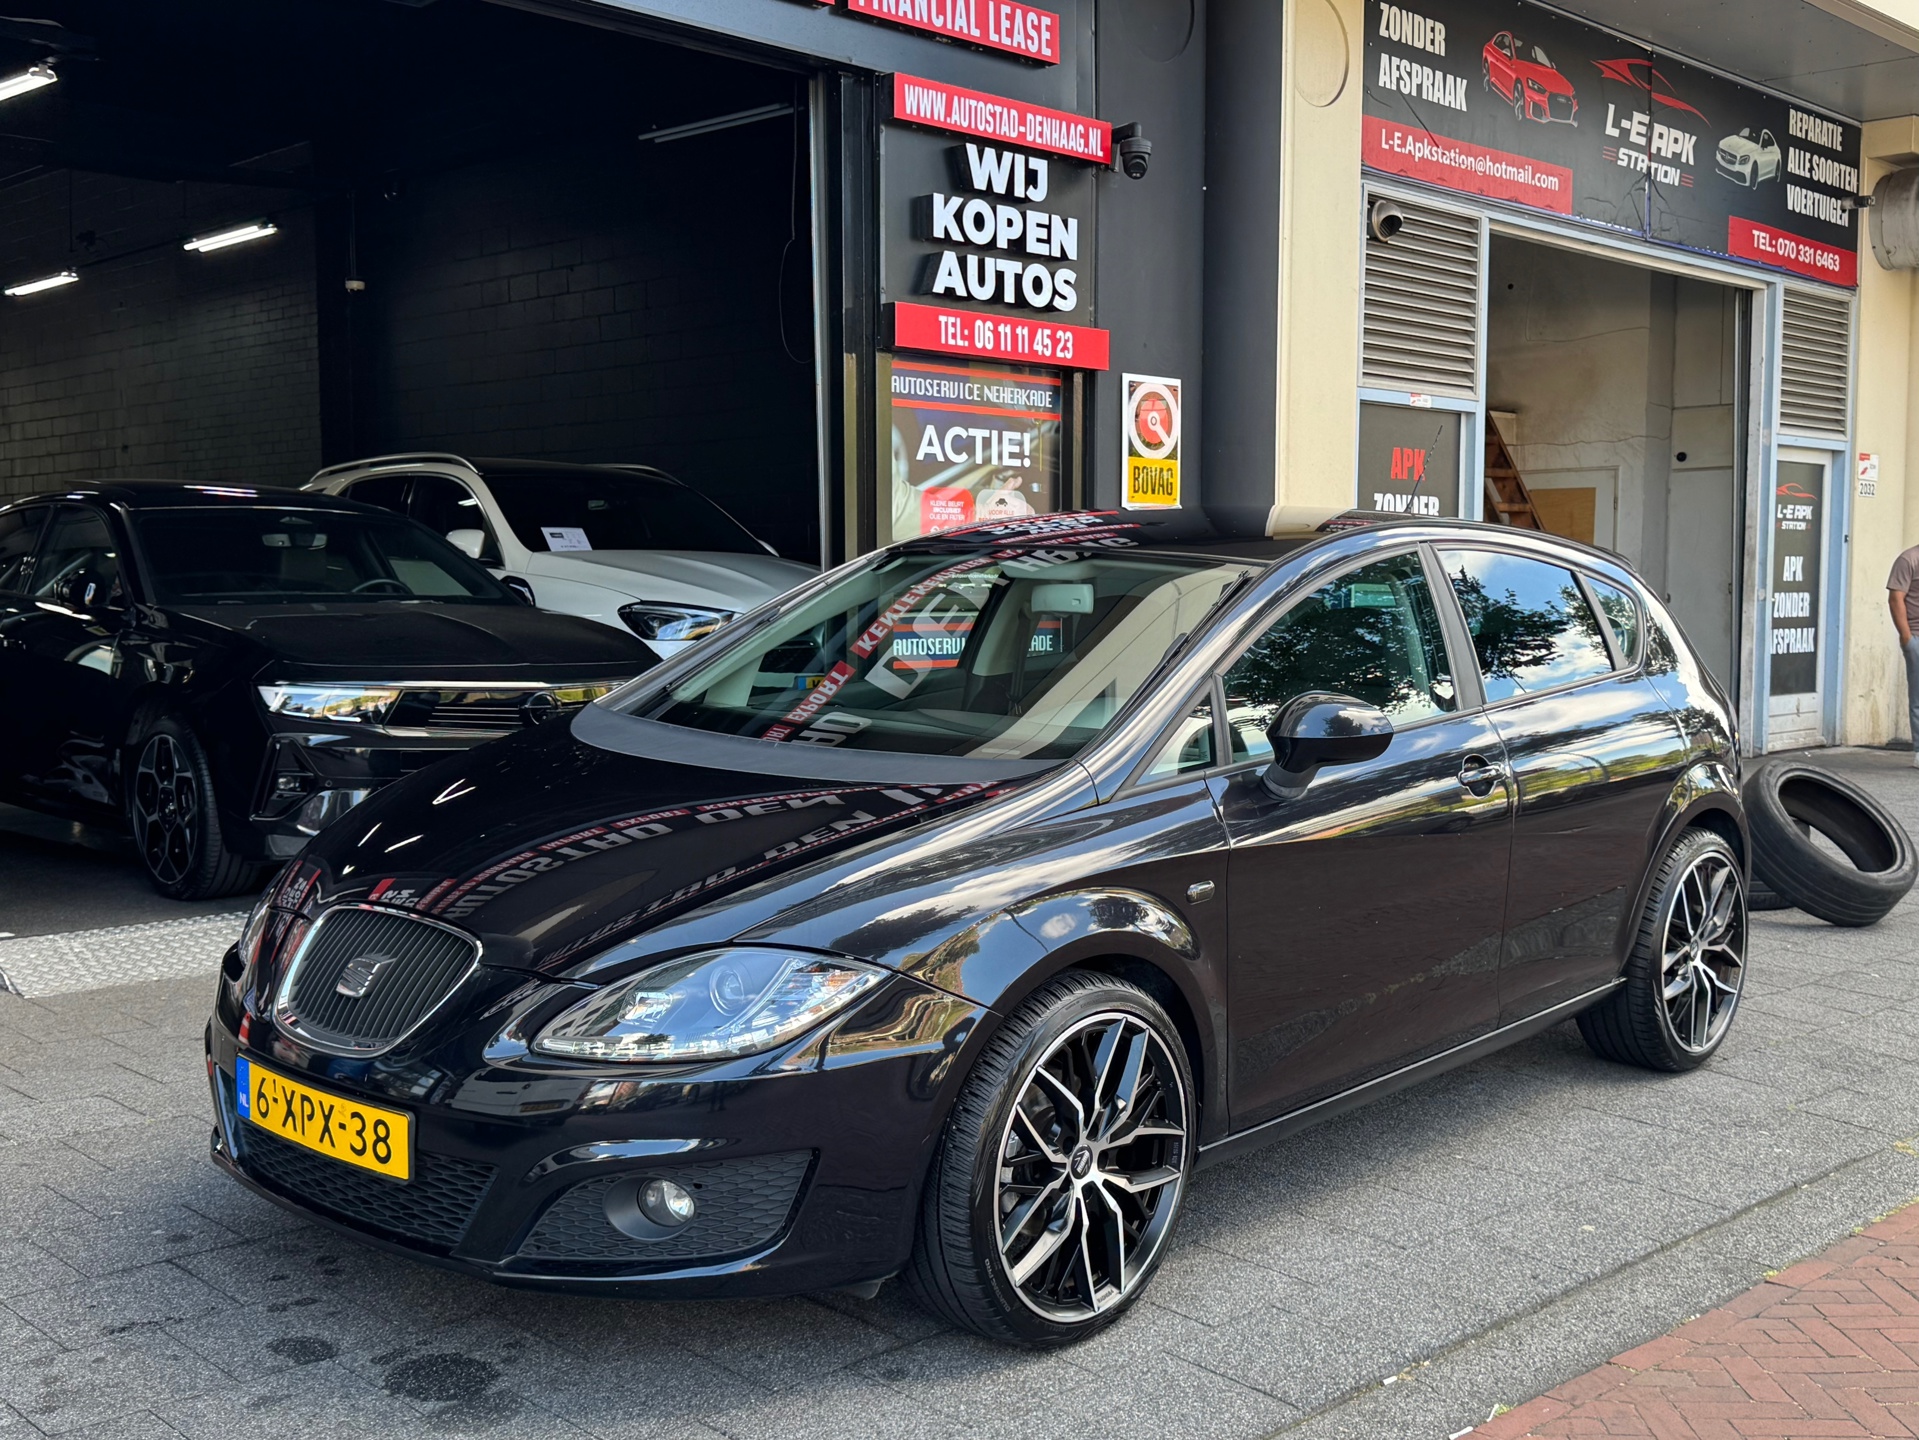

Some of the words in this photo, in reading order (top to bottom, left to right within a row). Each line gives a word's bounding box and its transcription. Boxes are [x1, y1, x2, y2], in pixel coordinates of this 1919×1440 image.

[988, 0, 1053, 57] LEASE
[1378, 1, 1447, 57] ZONDER
[1378, 52, 1468, 112] AFSPRAAK
[904, 83, 1104, 158] WWW.AUTOSTAD-DENHAAG.NL
[1788, 108, 1844, 153] REPARATIE
[1381, 127, 1560, 192] L-E.Apkstation@hotmail.com
[1650, 122, 1698, 165] APK
[965, 142, 1049, 202] WIJ
[1617, 148, 1681, 187] STATION
[1787, 146, 1813, 179] ALLE
[1813, 153, 1858, 194] SOORTEN
[932, 192, 1079, 262] KOPEN
[1752, 229, 1777, 254] TEL:
[1777, 238, 1798, 261] 070
[1798, 243, 1816, 266] 331
[1815, 247, 1841, 273] 6463
[932, 250, 1078, 313] AUTOS
[938, 315, 970, 347] TEL:
[974, 319, 994, 349] 06
[997, 322, 1012, 353] 11
[1015, 326, 1029, 355] 11
[1033, 327, 1052, 357] 45
[1056, 330, 1074, 360] 23
[891, 374, 981, 401] AUTOSERVICE
[983, 384, 1053, 408] NEHERKADE
[915, 424, 1032, 468] ACTIE!
[1390, 447, 1426, 481] APK
[1132, 464, 1174, 497] BOVAG
[1859, 482, 1876, 496] 2032
[1783, 556, 1804, 582] APK
[1773, 592, 1810, 618] ZONDER
[893, 637, 965, 656] AUTOSERVI
[1028, 635, 1054, 651] ADE
[239, 1091, 249, 1108] NL
[256, 1076, 392, 1165] 6-XPX-38
